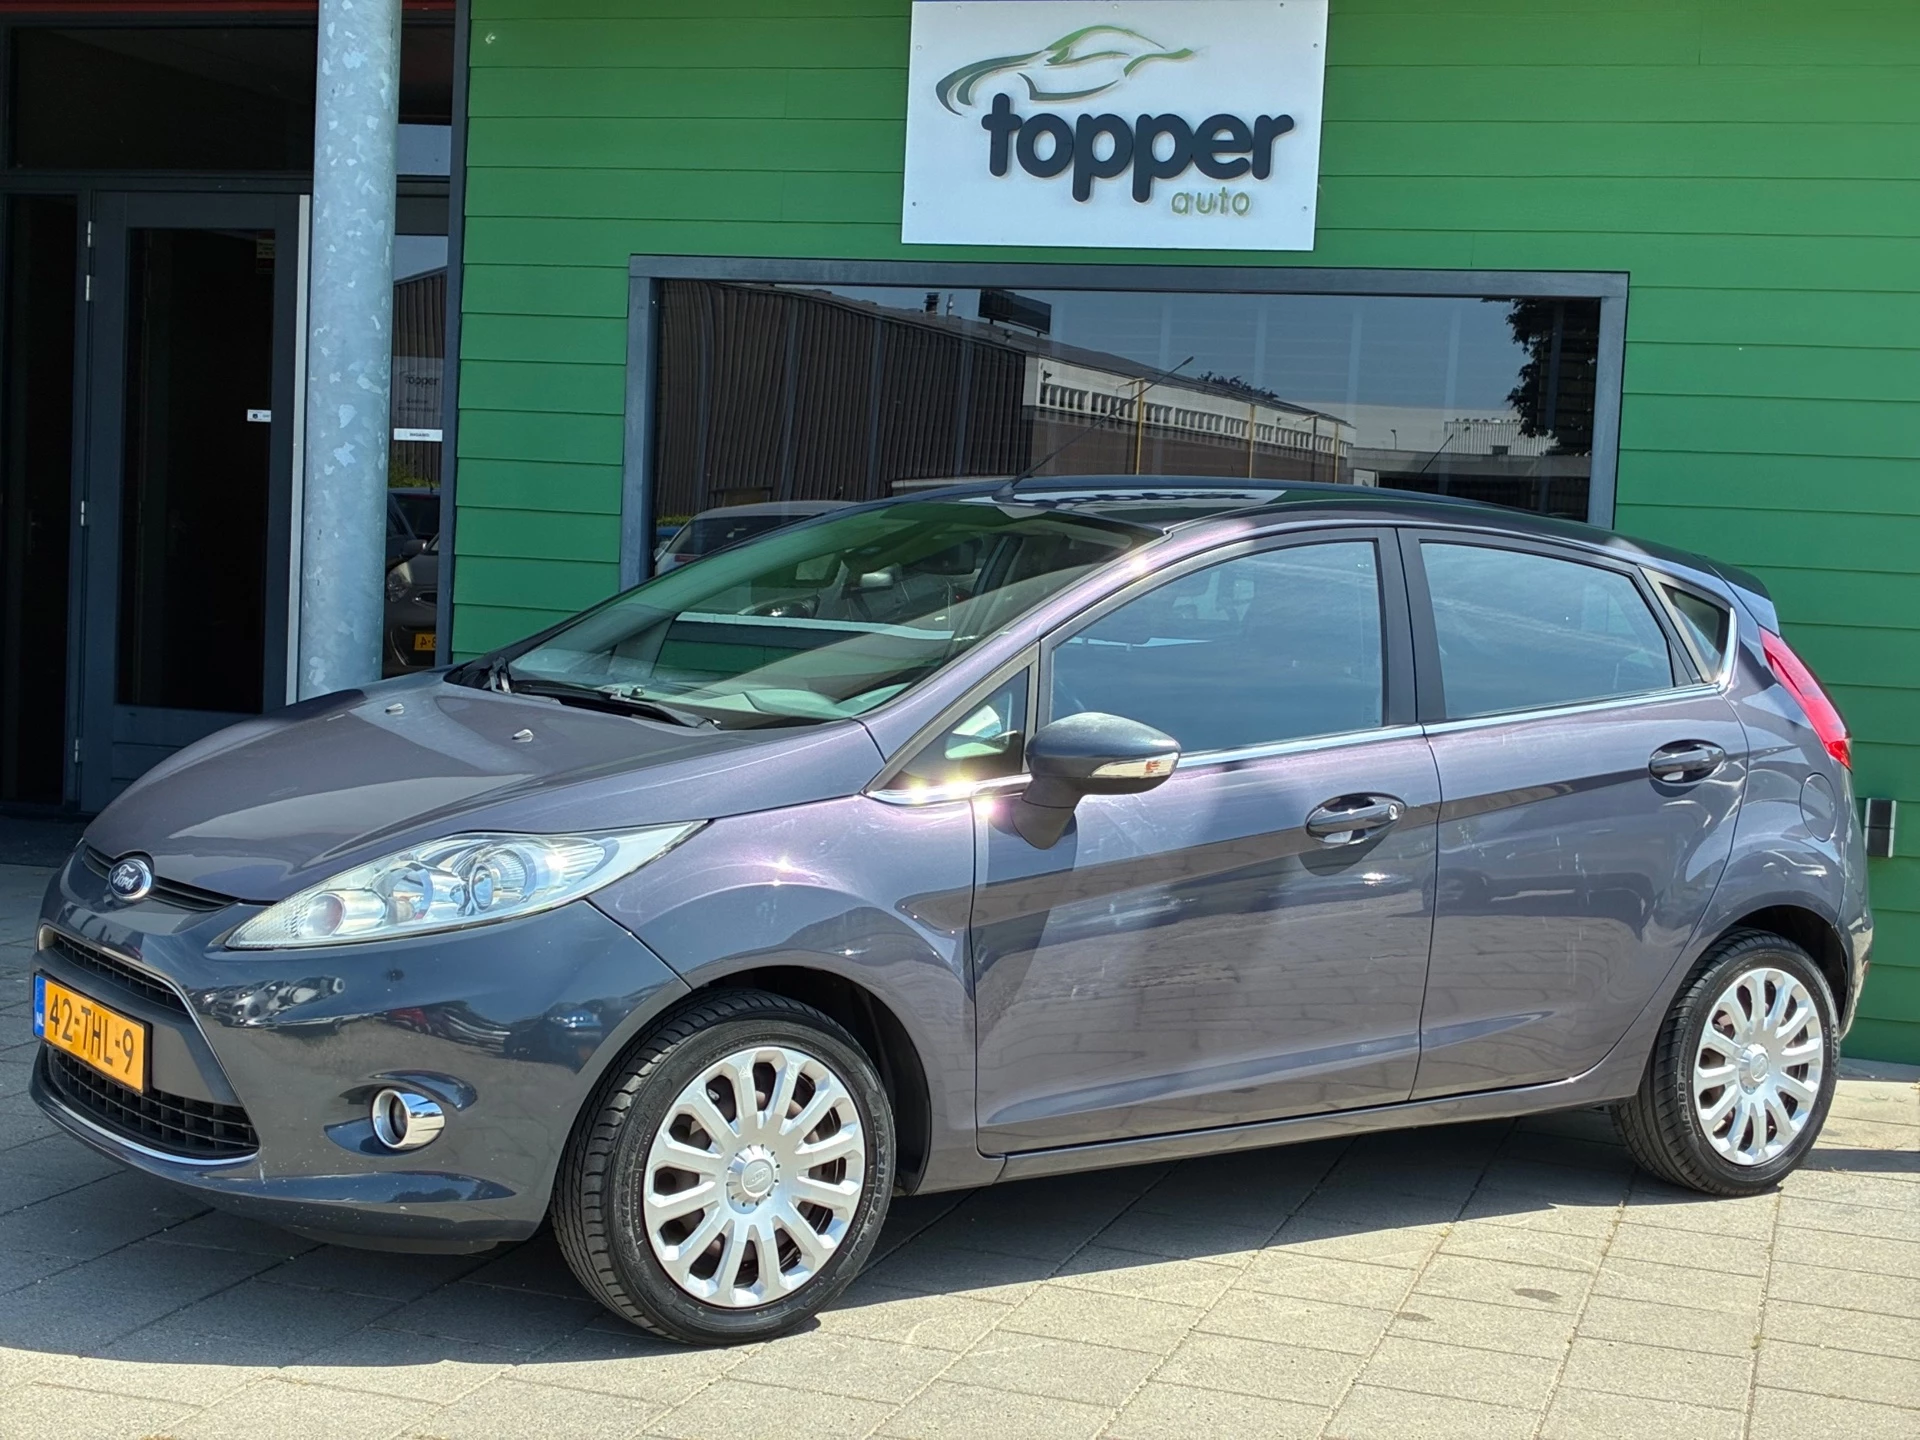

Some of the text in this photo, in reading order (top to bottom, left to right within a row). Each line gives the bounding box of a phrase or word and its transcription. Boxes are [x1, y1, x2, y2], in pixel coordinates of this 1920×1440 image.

[981, 93, 1294, 203] topper
[1172, 187, 1250, 216] auto
[112, 864, 138, 890] Ford
[50, 994, 134, 1075] 42-THL-9
[867, 1114, 886, 1226] MAXIMUS
